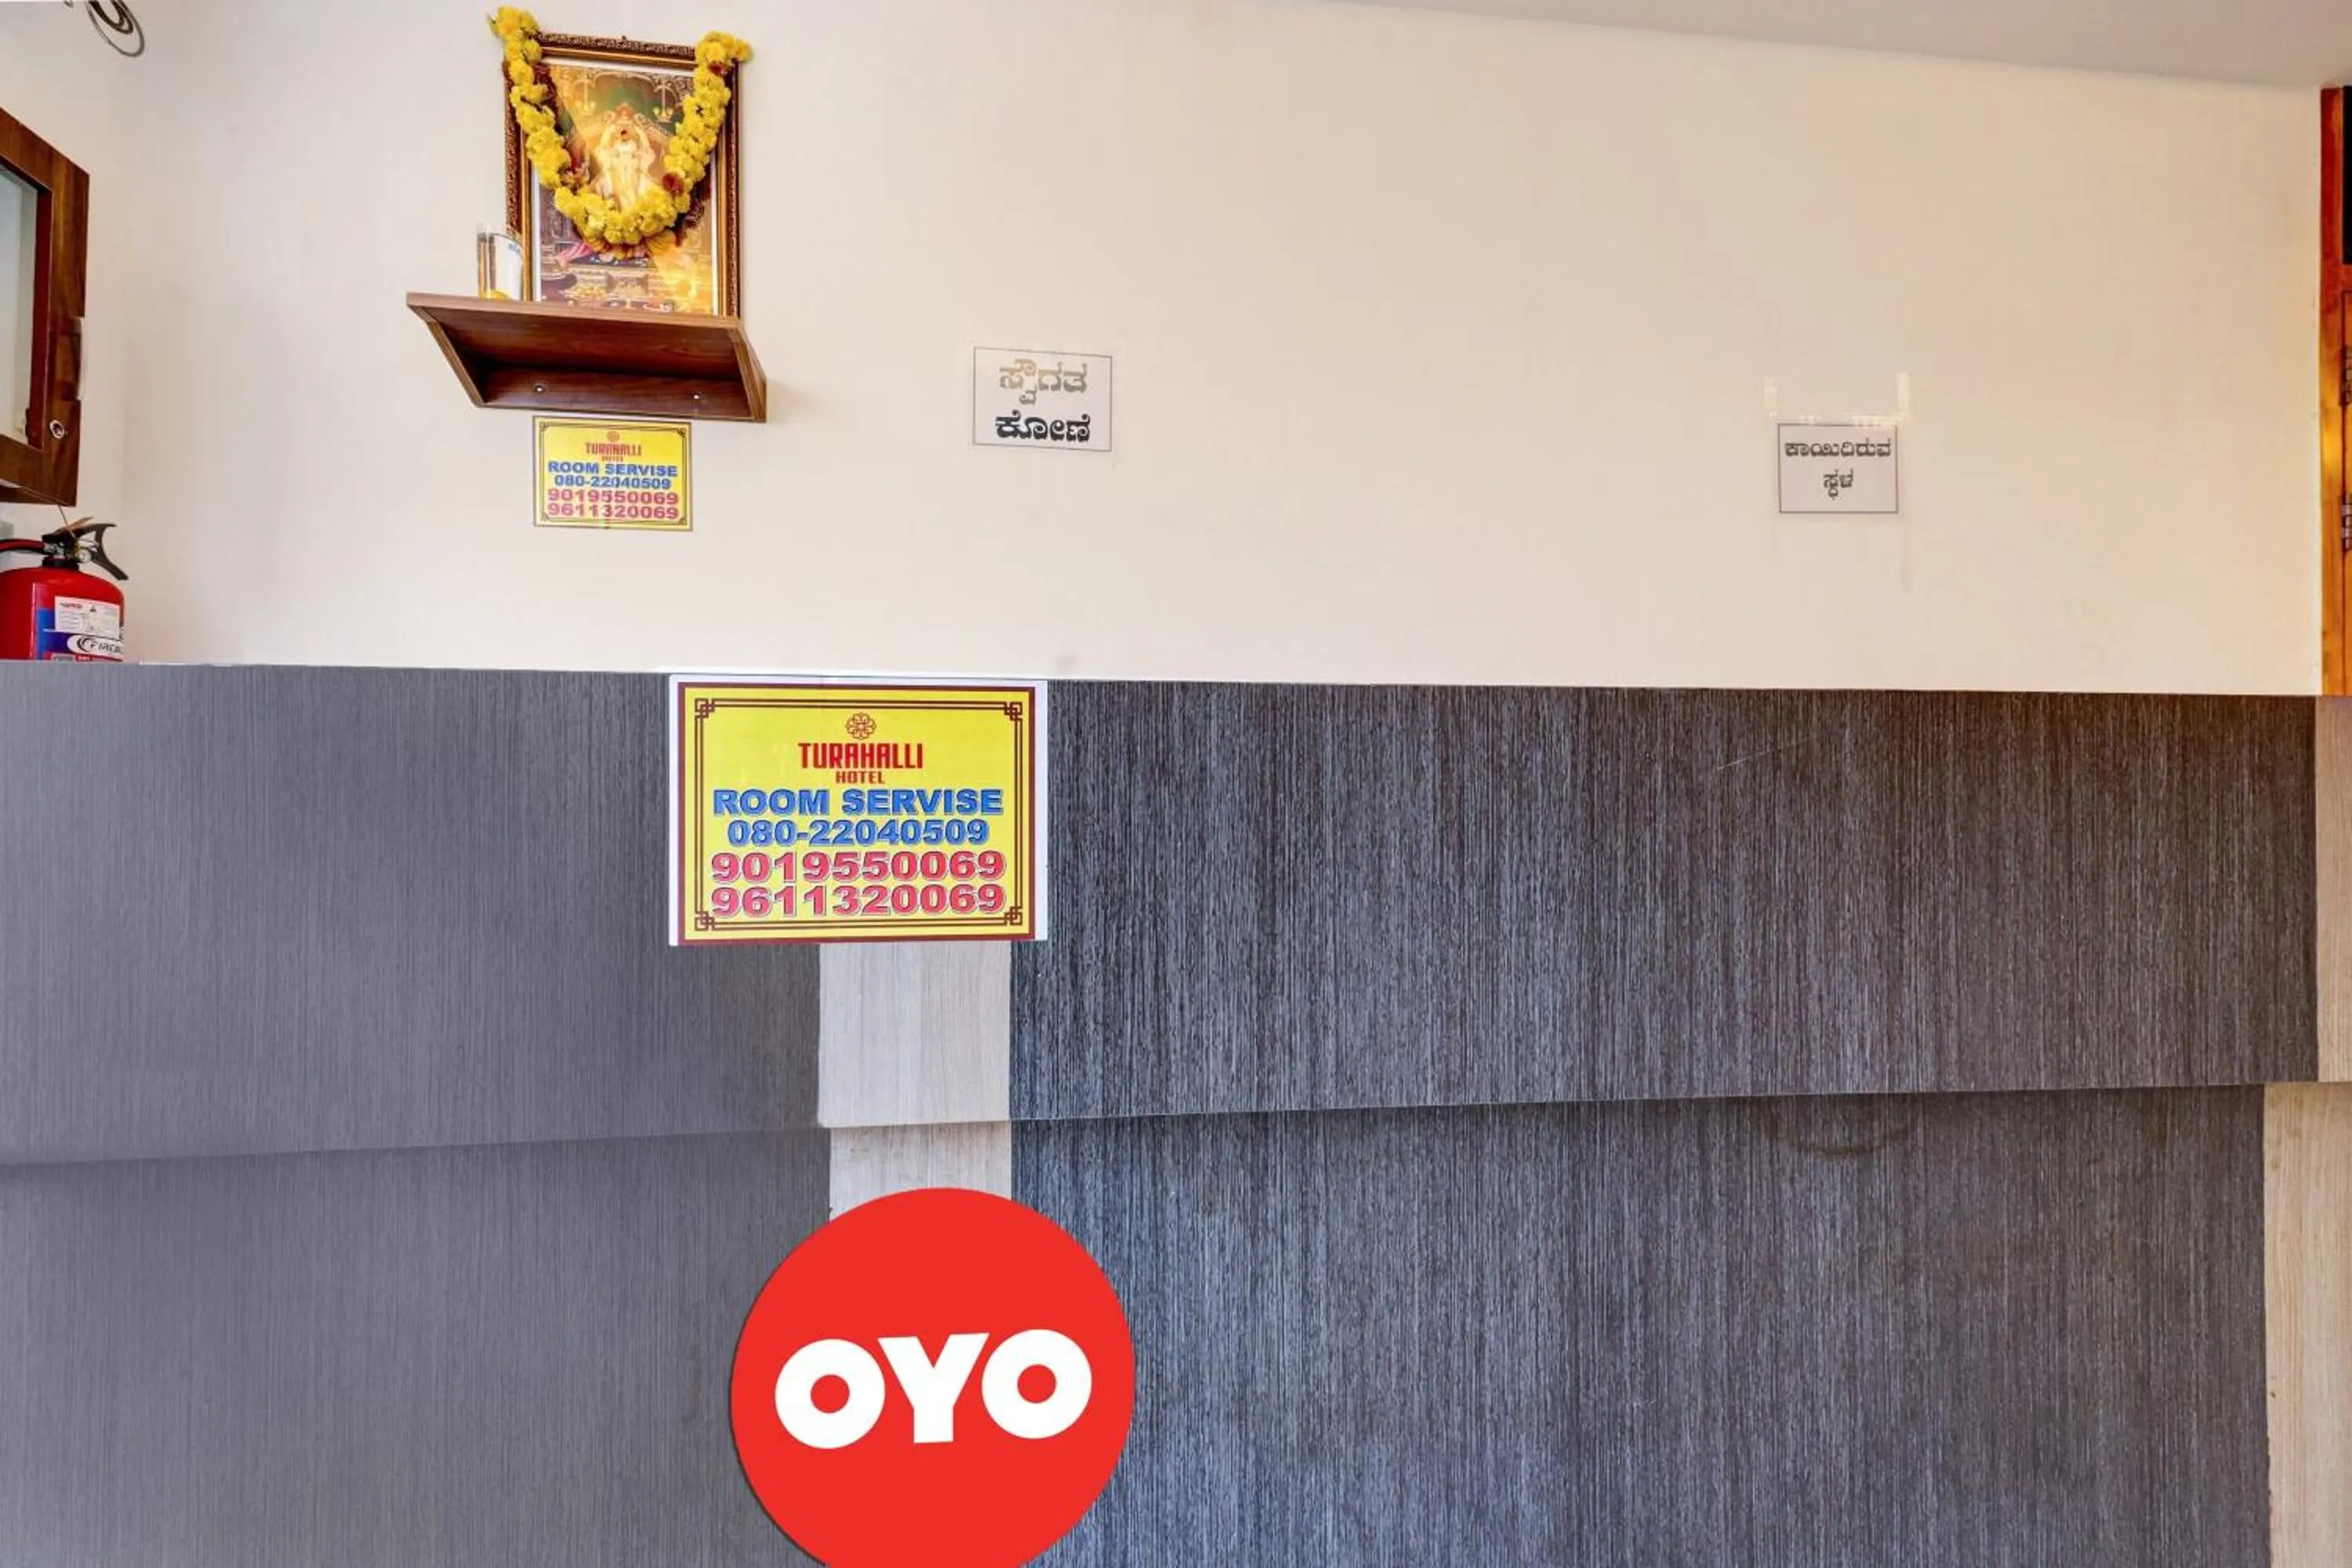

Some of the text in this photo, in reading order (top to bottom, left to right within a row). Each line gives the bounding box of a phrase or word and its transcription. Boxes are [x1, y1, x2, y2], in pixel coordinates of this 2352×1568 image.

[995, 409, 1091, 443] ಕೋಣೆ
[548, 461, 678, 477] ROOM SERVISE
[554, 474, 672, 490] 080-22040509
[548, 488, 679, 505] 9019550069
[548, 503, 680, 520] 9611320069
[798, 742, 924, 769] TURAHALLI
[836, 771, 885, 784] HOTEL
[713, 789, 1004, 816] ROOM SERVISE
[727, 819, 990, 847] 080-22040509
[711, 851, 1007, 884] 9019550069
[711, 884, 1007, 916] 9611320069
[775, 1329, 1092, 1449] OYO
